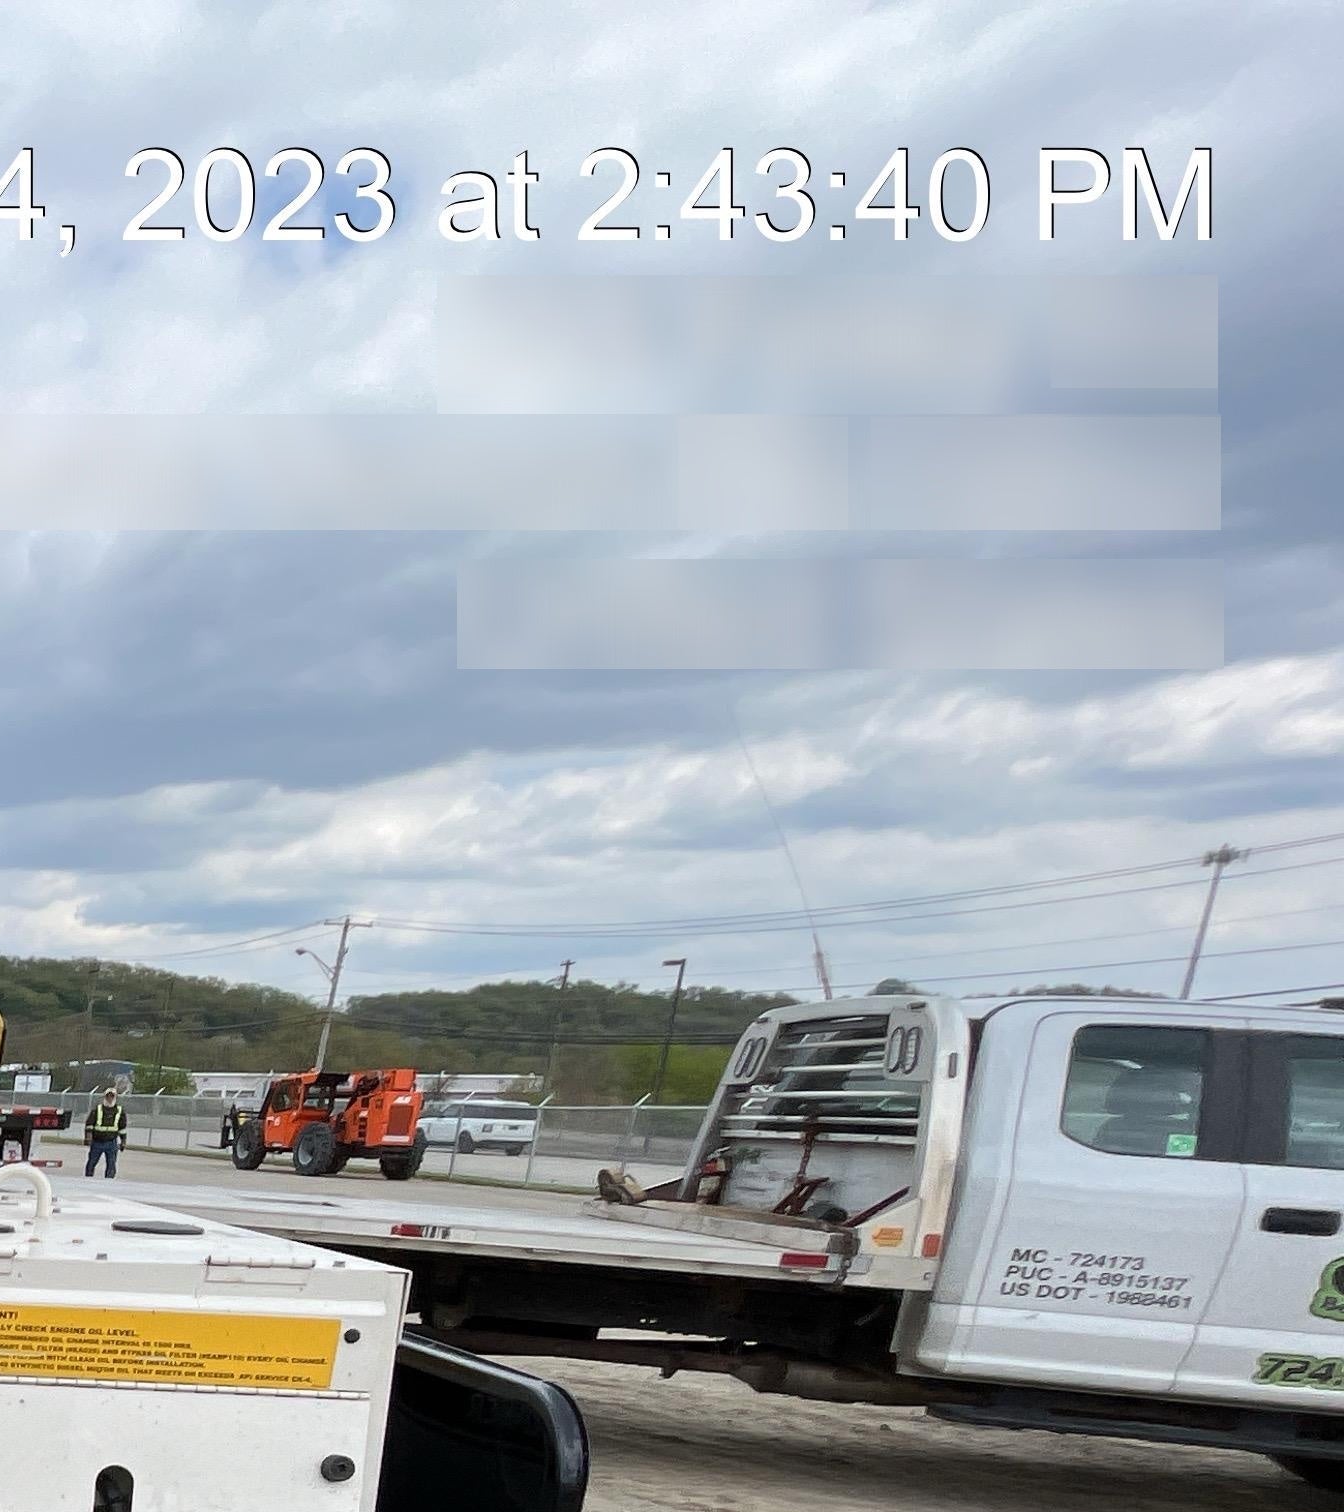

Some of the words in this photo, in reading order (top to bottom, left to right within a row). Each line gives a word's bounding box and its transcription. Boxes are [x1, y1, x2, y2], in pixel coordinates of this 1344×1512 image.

[1011, 1248, 1049, 1264] MC
[1069, 1252, 1146, 1271] 724173
[1004, 1265, 1054, 1281] PUC
[1000, 1282, 1031, 1298] US
[1035, 1284, 1086, 1301] DOT
[14, 1324, 47, 1333] CHECK
[50, 1326, 86, 1335] ENGINE
[88, 1328, 104, 1336] OIL
